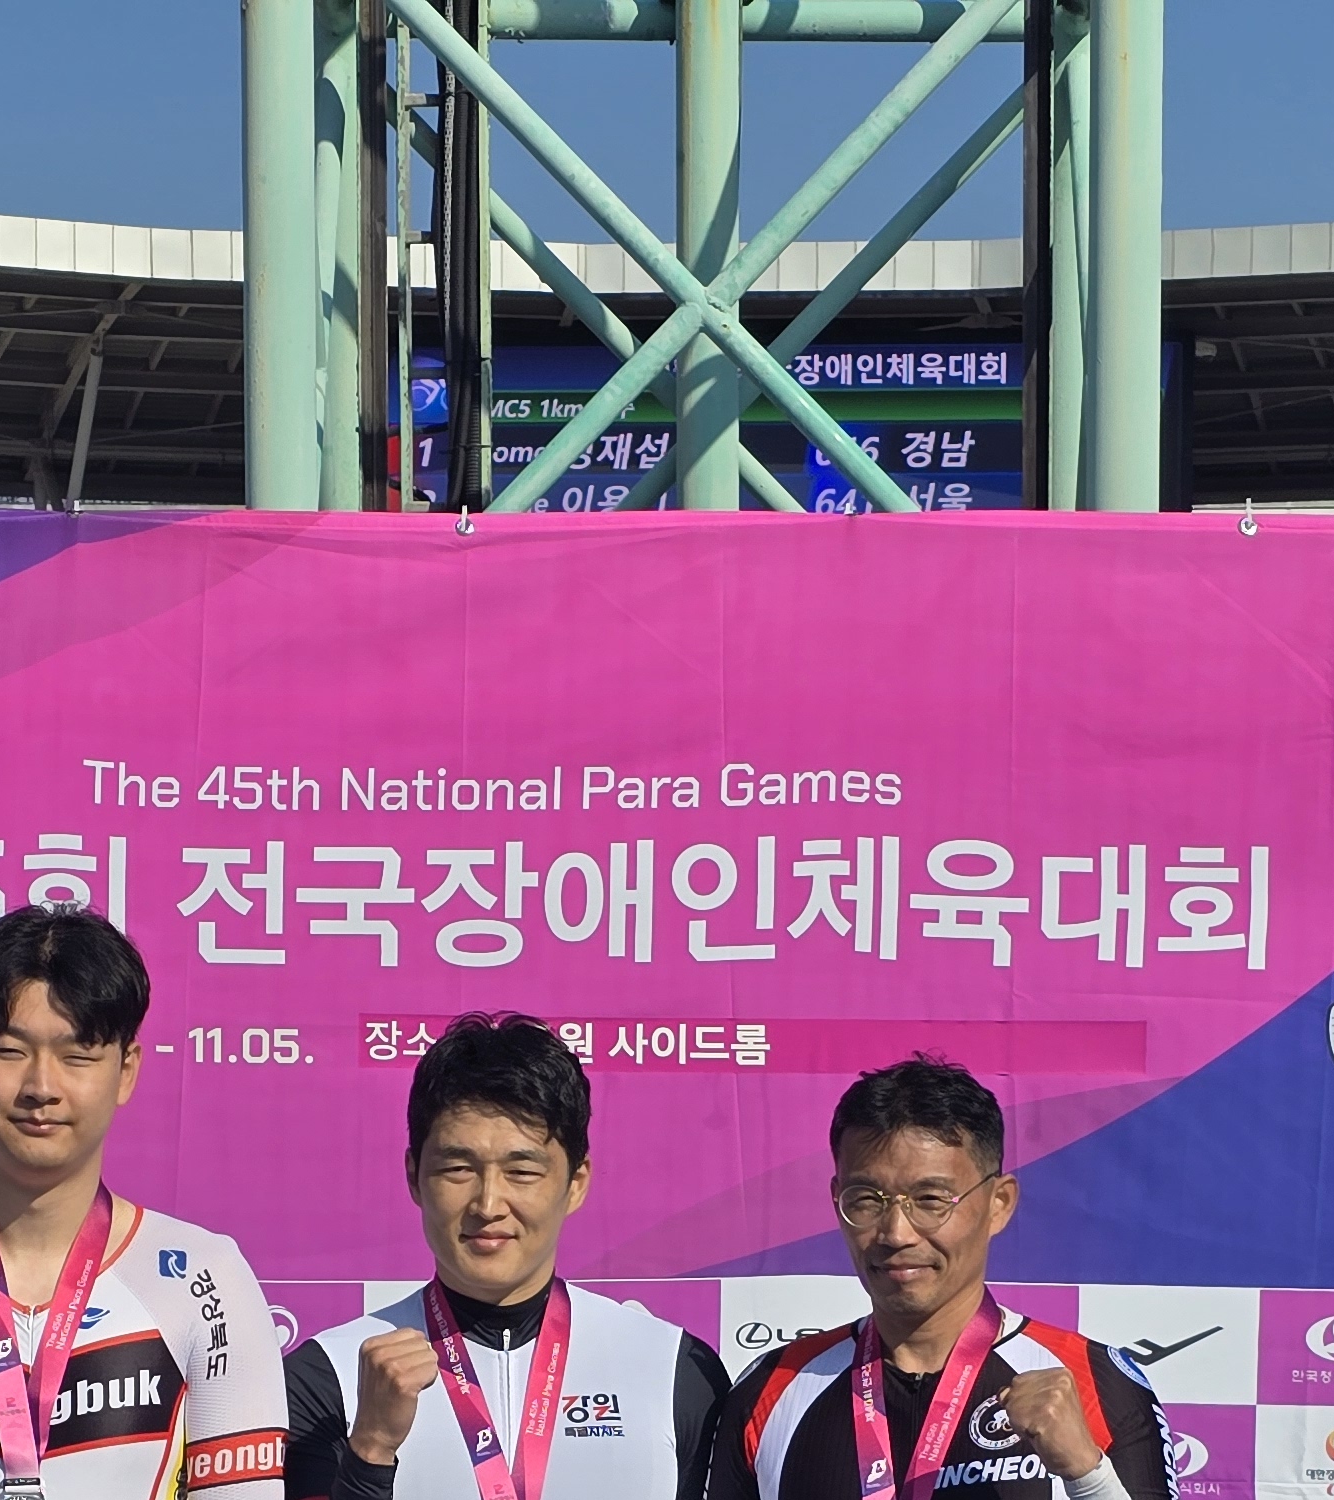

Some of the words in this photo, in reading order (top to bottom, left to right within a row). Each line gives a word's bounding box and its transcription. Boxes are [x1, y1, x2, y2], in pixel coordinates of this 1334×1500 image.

[789, 352, 1008, 385] 장애인체육대회
[901, 431, 976, 468] 경남
[83, 759, 180, 808] The
[198, 762, 321, 810] 45th
[337, 764, 565, 814] National
[581, 763, 702, 813] Para
[718, 760, 903, 810] Games
[176, 836, 1271, 971] 전국장애인체육대회
[186, 1027, 315, 1066] 11.05.
[606, 1022, 772, 1066] 사이드롬
[190, 1268, 228, 1381] 경상북도
[562, 1393, 622, 1423] 강원
[186, 1436, 286, 1479] yeongb
